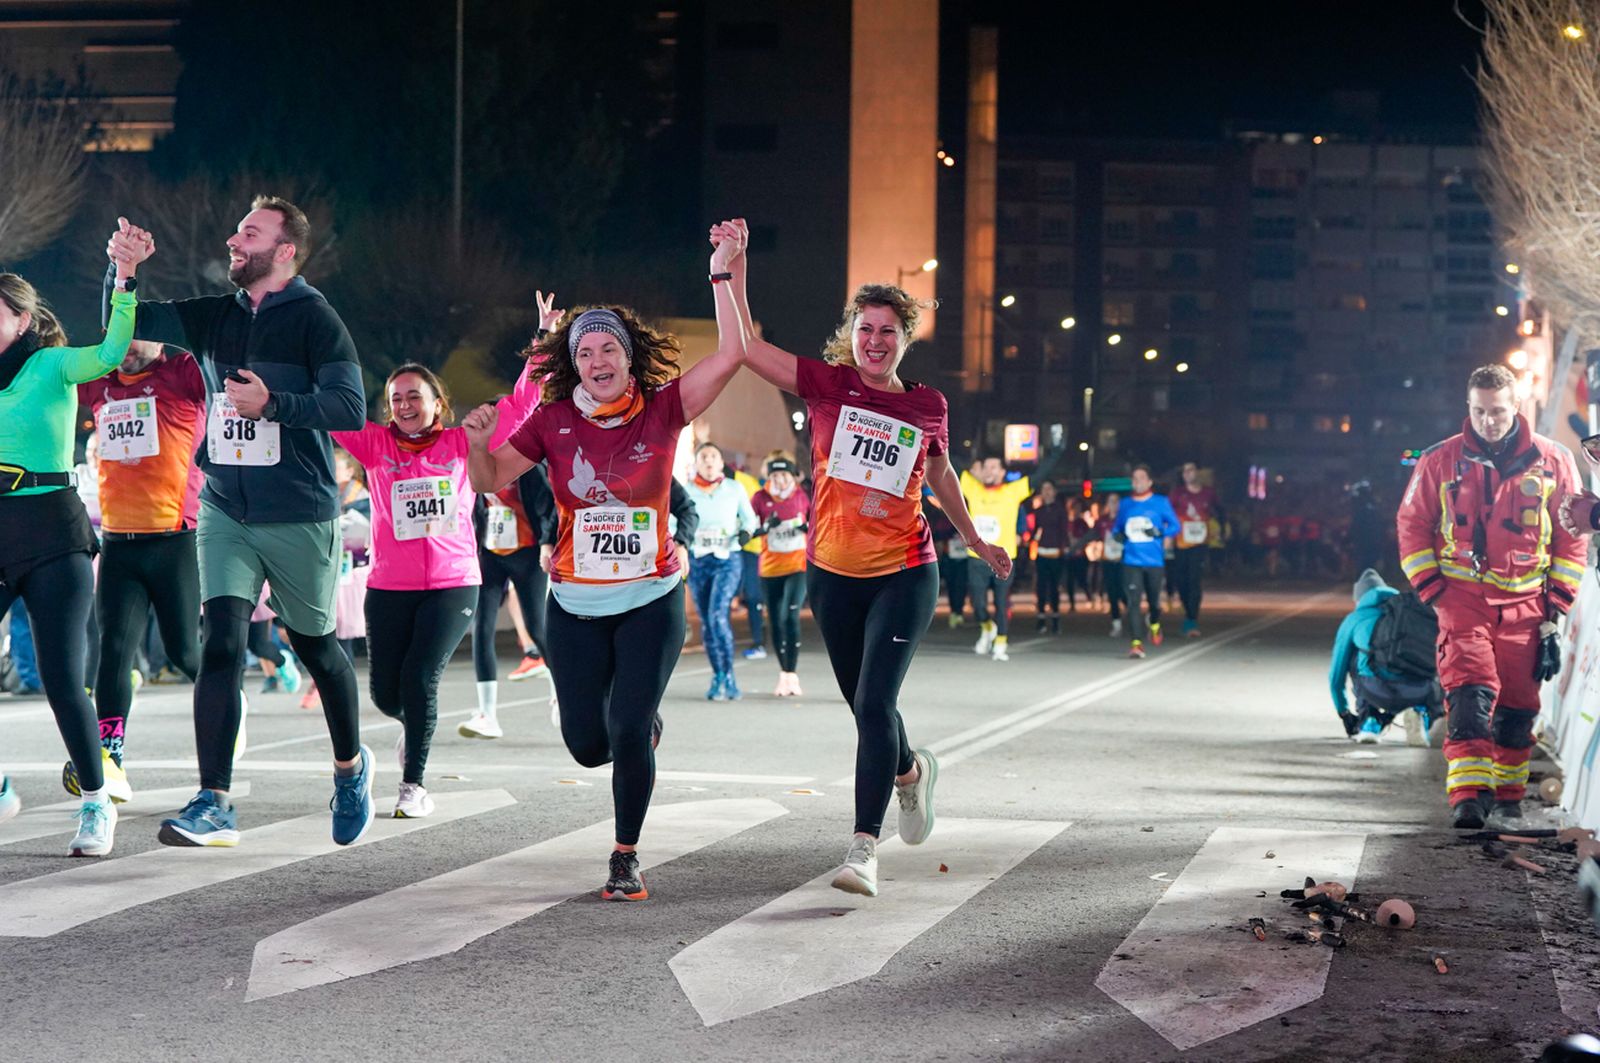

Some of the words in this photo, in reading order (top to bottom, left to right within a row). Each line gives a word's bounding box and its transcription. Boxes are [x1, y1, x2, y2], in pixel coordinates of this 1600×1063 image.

[108, 420, 145, 441] 3442
[223, 419, 256, 441] 318
[846, 423, 862, 434] SAN
[857, 417, 882, 431] NOCHE
[883, 424, 893, 433] DE
[851, 434, 900, 467] 7196
[404, 484, 424, 493] NOCHE
[585, 486, 608, 504] 43
[406, 498, 445, 519] 3441
[583, 524, 600, 533] SAN
[590, 532, 641, 555] 7206
